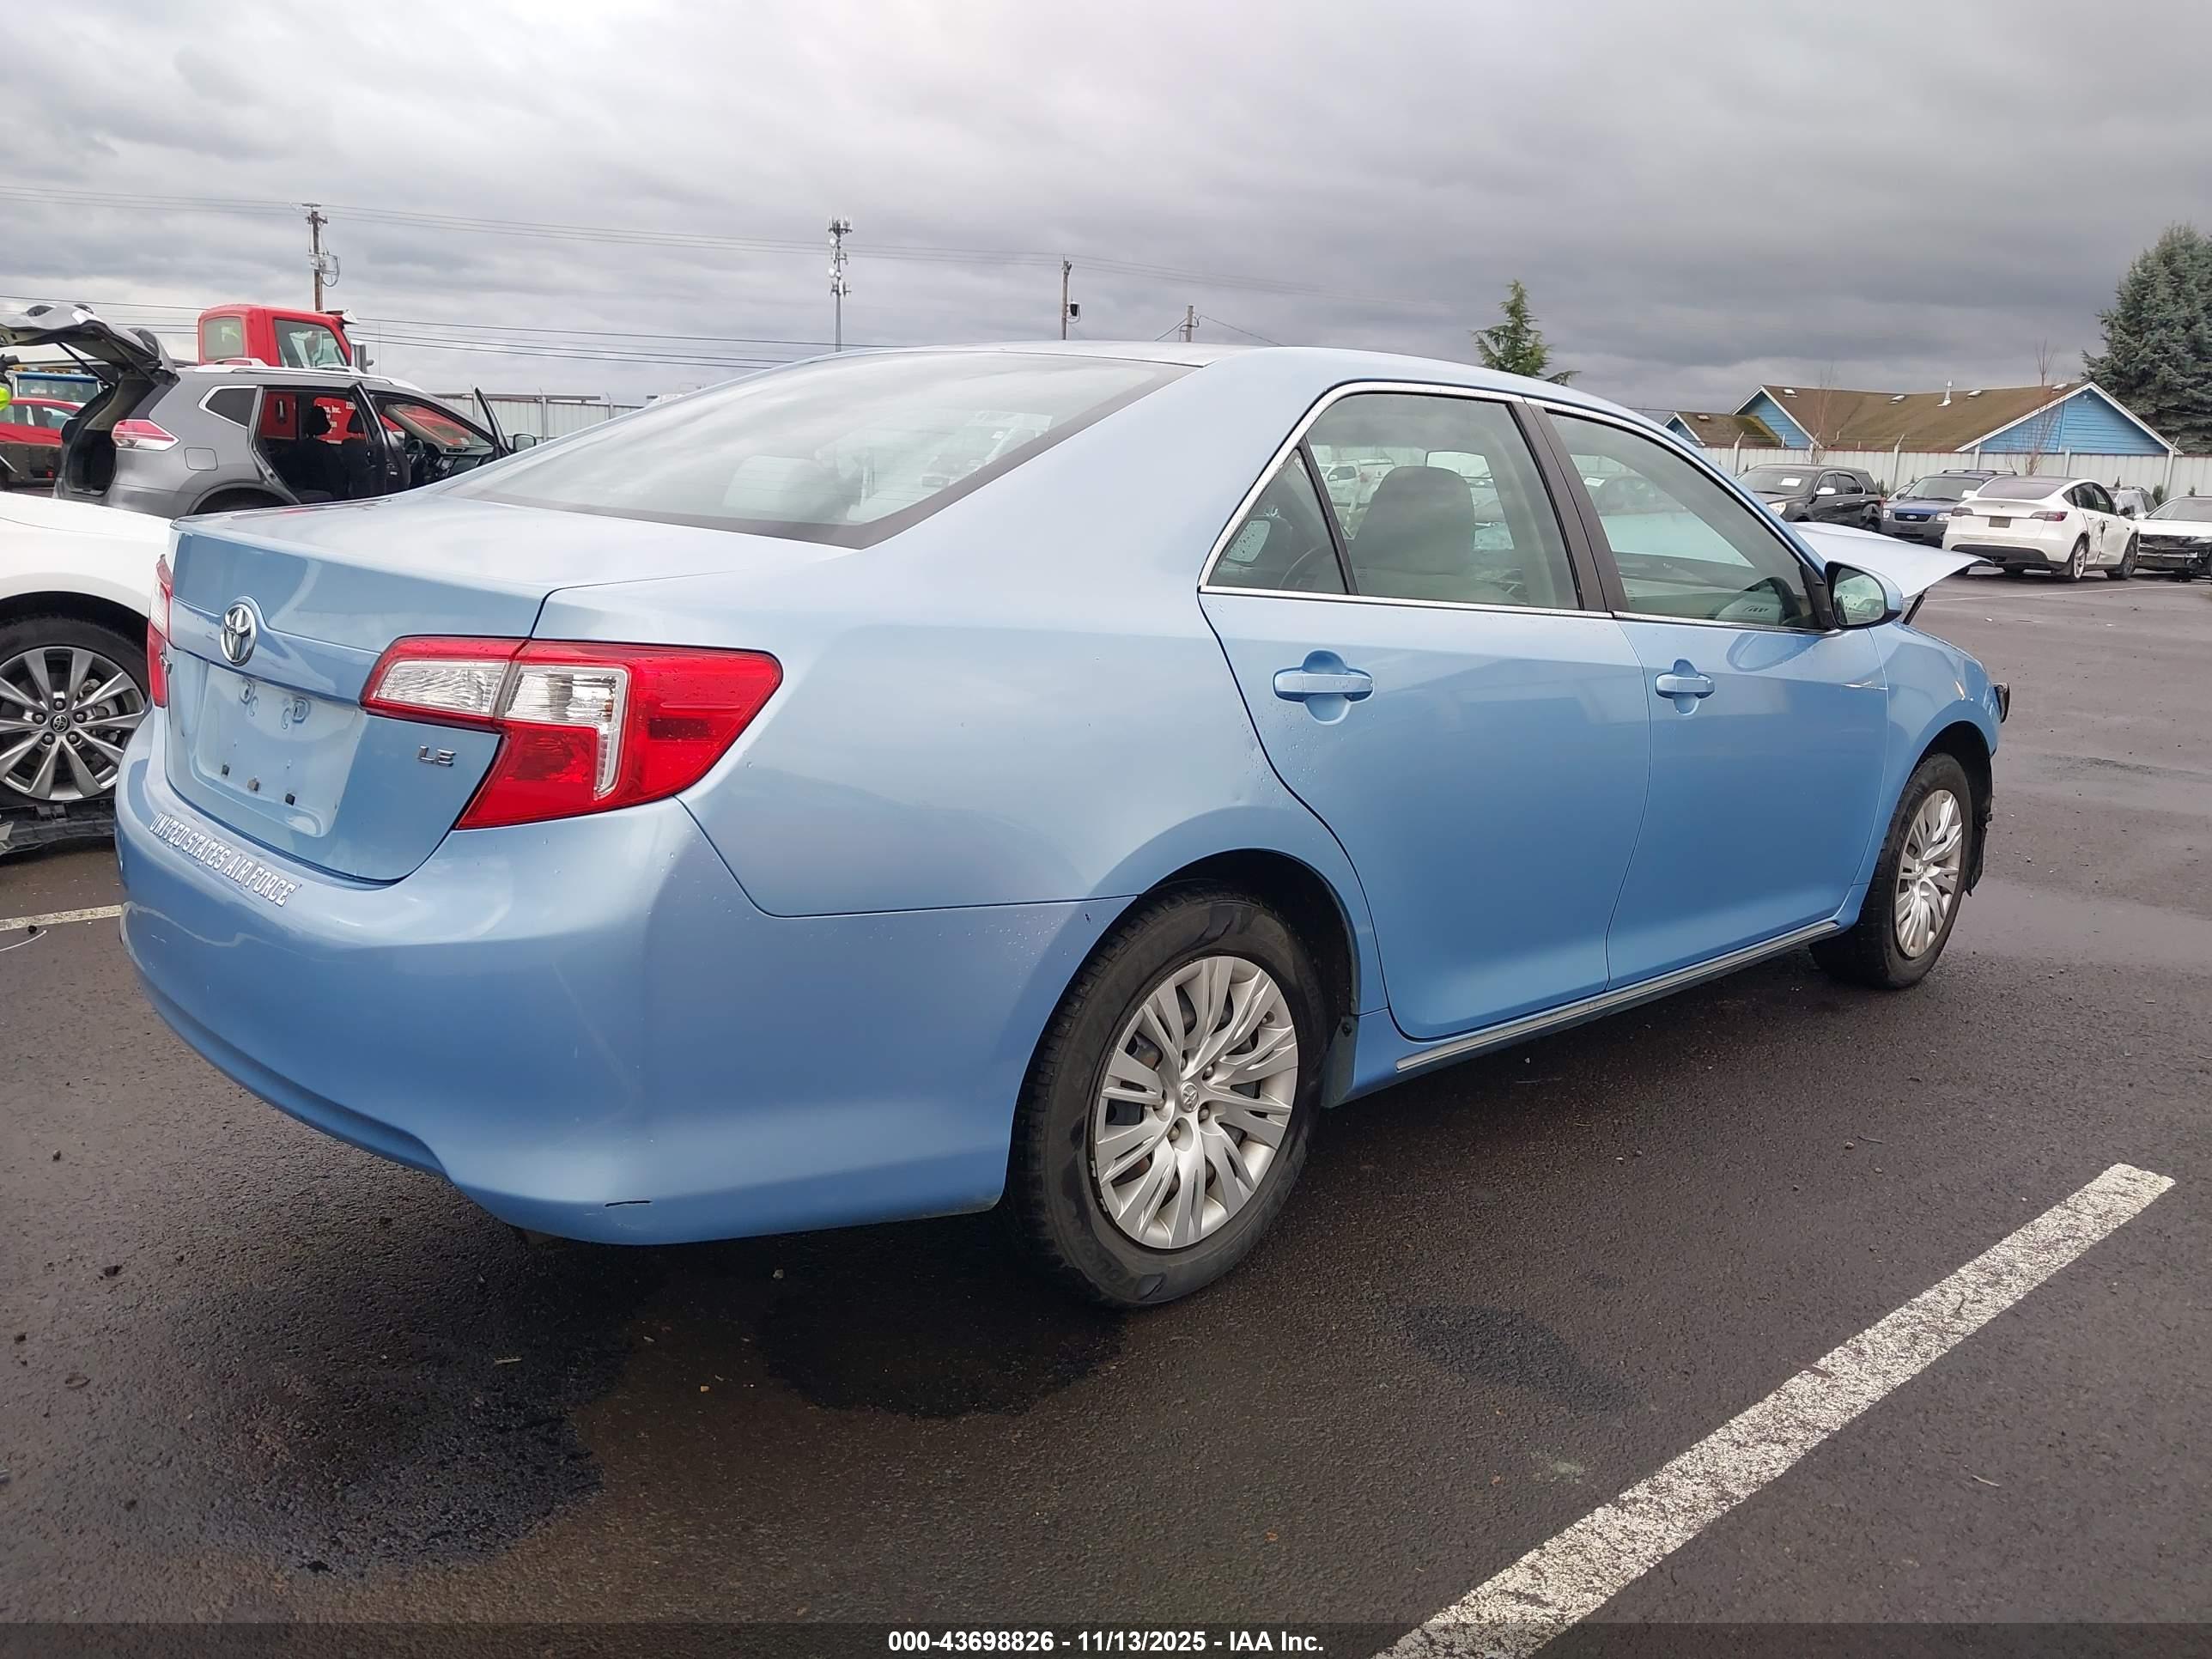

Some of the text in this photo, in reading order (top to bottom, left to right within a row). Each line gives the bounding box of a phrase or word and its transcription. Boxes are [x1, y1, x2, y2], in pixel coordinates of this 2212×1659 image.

[419, 744, 456, 767] LE
[149, 811, 297, 908] UNITED STATES AIR FORCE
